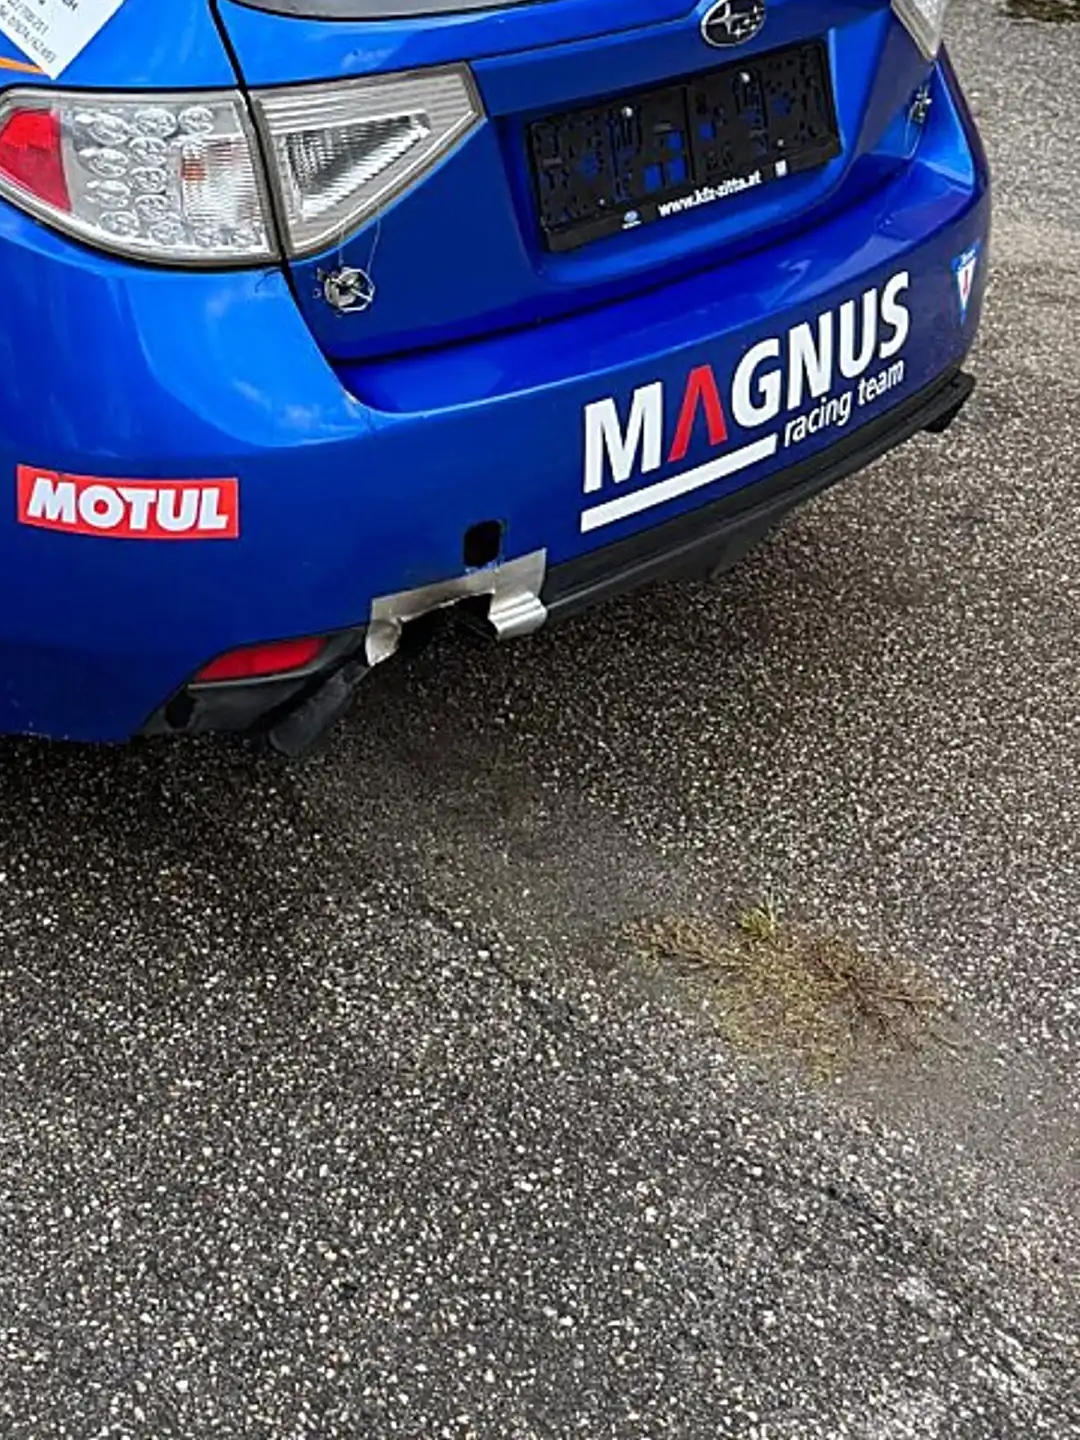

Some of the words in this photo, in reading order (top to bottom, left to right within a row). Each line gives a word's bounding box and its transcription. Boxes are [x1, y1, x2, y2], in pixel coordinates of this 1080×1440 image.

[582, 271, 910, 494] MAGNUS
[784, 396, 852, 447] racing
[857, 359, 904, 405] team
[27, 477, 229, 531] MOTUL
